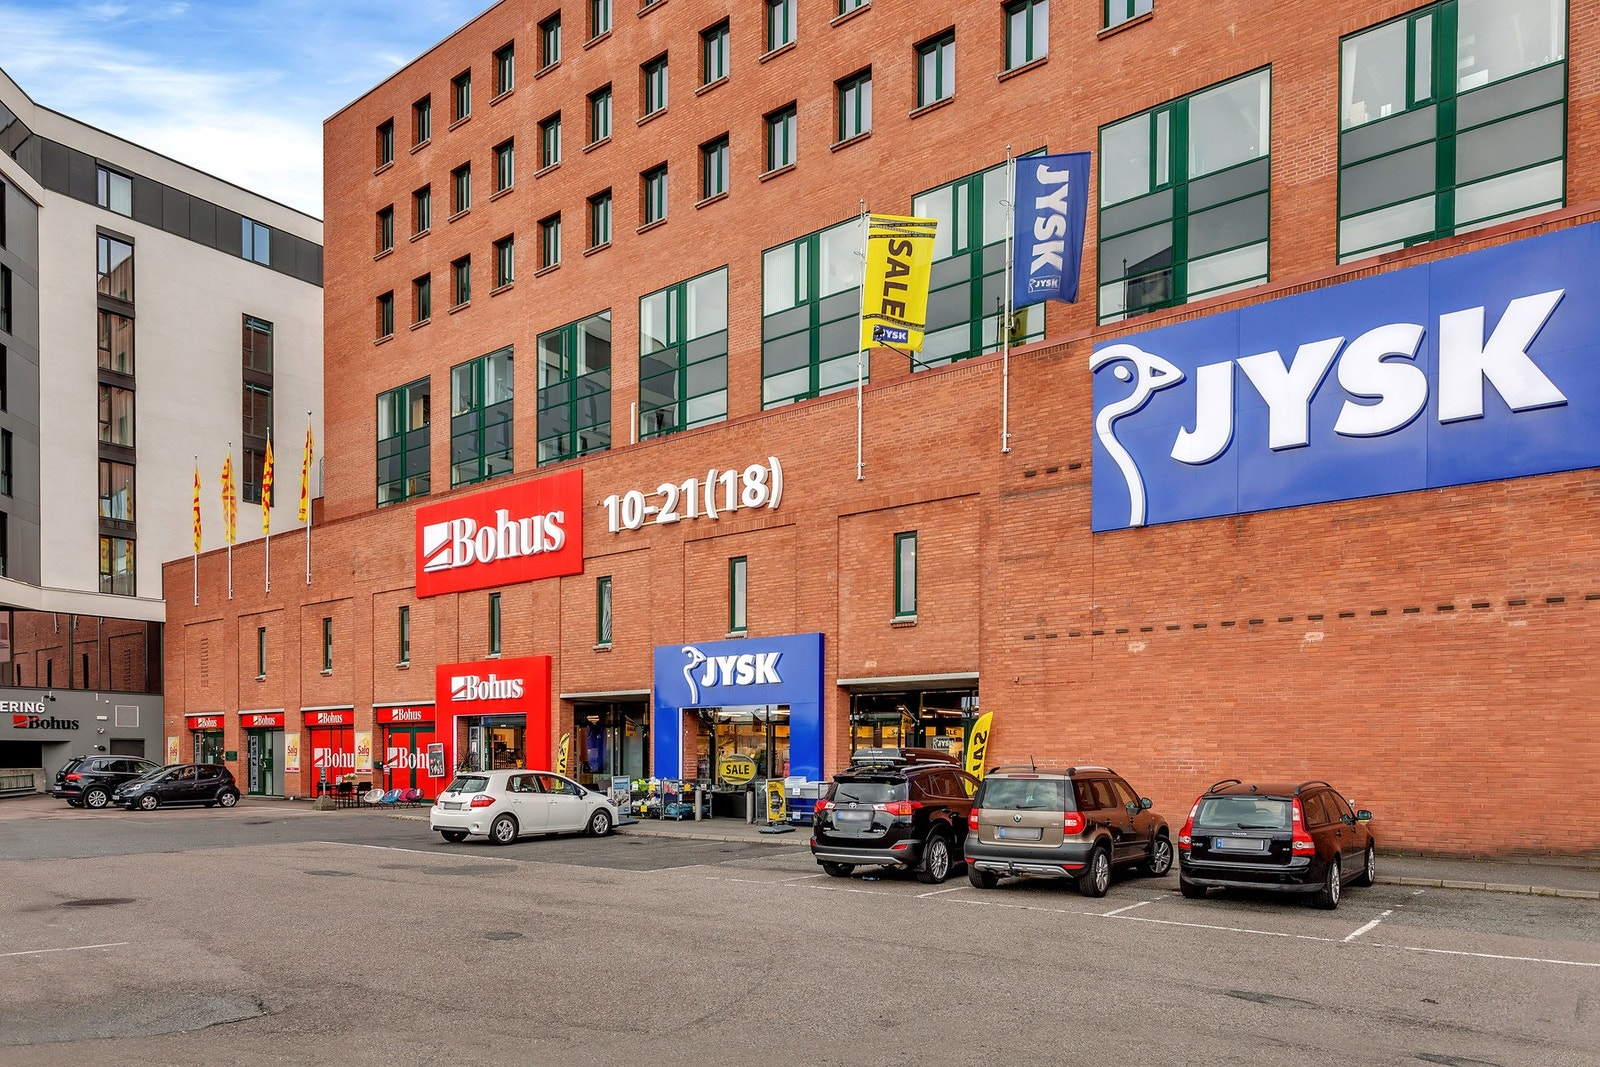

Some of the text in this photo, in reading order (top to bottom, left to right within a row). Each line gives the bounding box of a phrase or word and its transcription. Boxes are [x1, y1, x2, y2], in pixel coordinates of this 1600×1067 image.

[1029, 163, 1070, 275] JYSK
[881, 238, 913, 319] SALE
[1035, 278, 1059, 288] JYSK
[1170, 288, 1568, 466] JYSK
[602, 455, 784, 534] 10-21(18)
[451, 508, 566, 569] Bohus
[701, 652, 784, 687] JYSK
[466, 673, 524, 701] Bohus
[259, 714, 276, 726] Bohus
[322, 712, 343, 724] Bohus
[398, 708, 422, 721] Bohus
[28, 714, 80, 731] Bohus
[201, 717, 218, 728] Bohus
[287, 744, 298, 757] Salg
[357, 744, 370, 757] Salg
[726, 764, 750, 775] SALE
